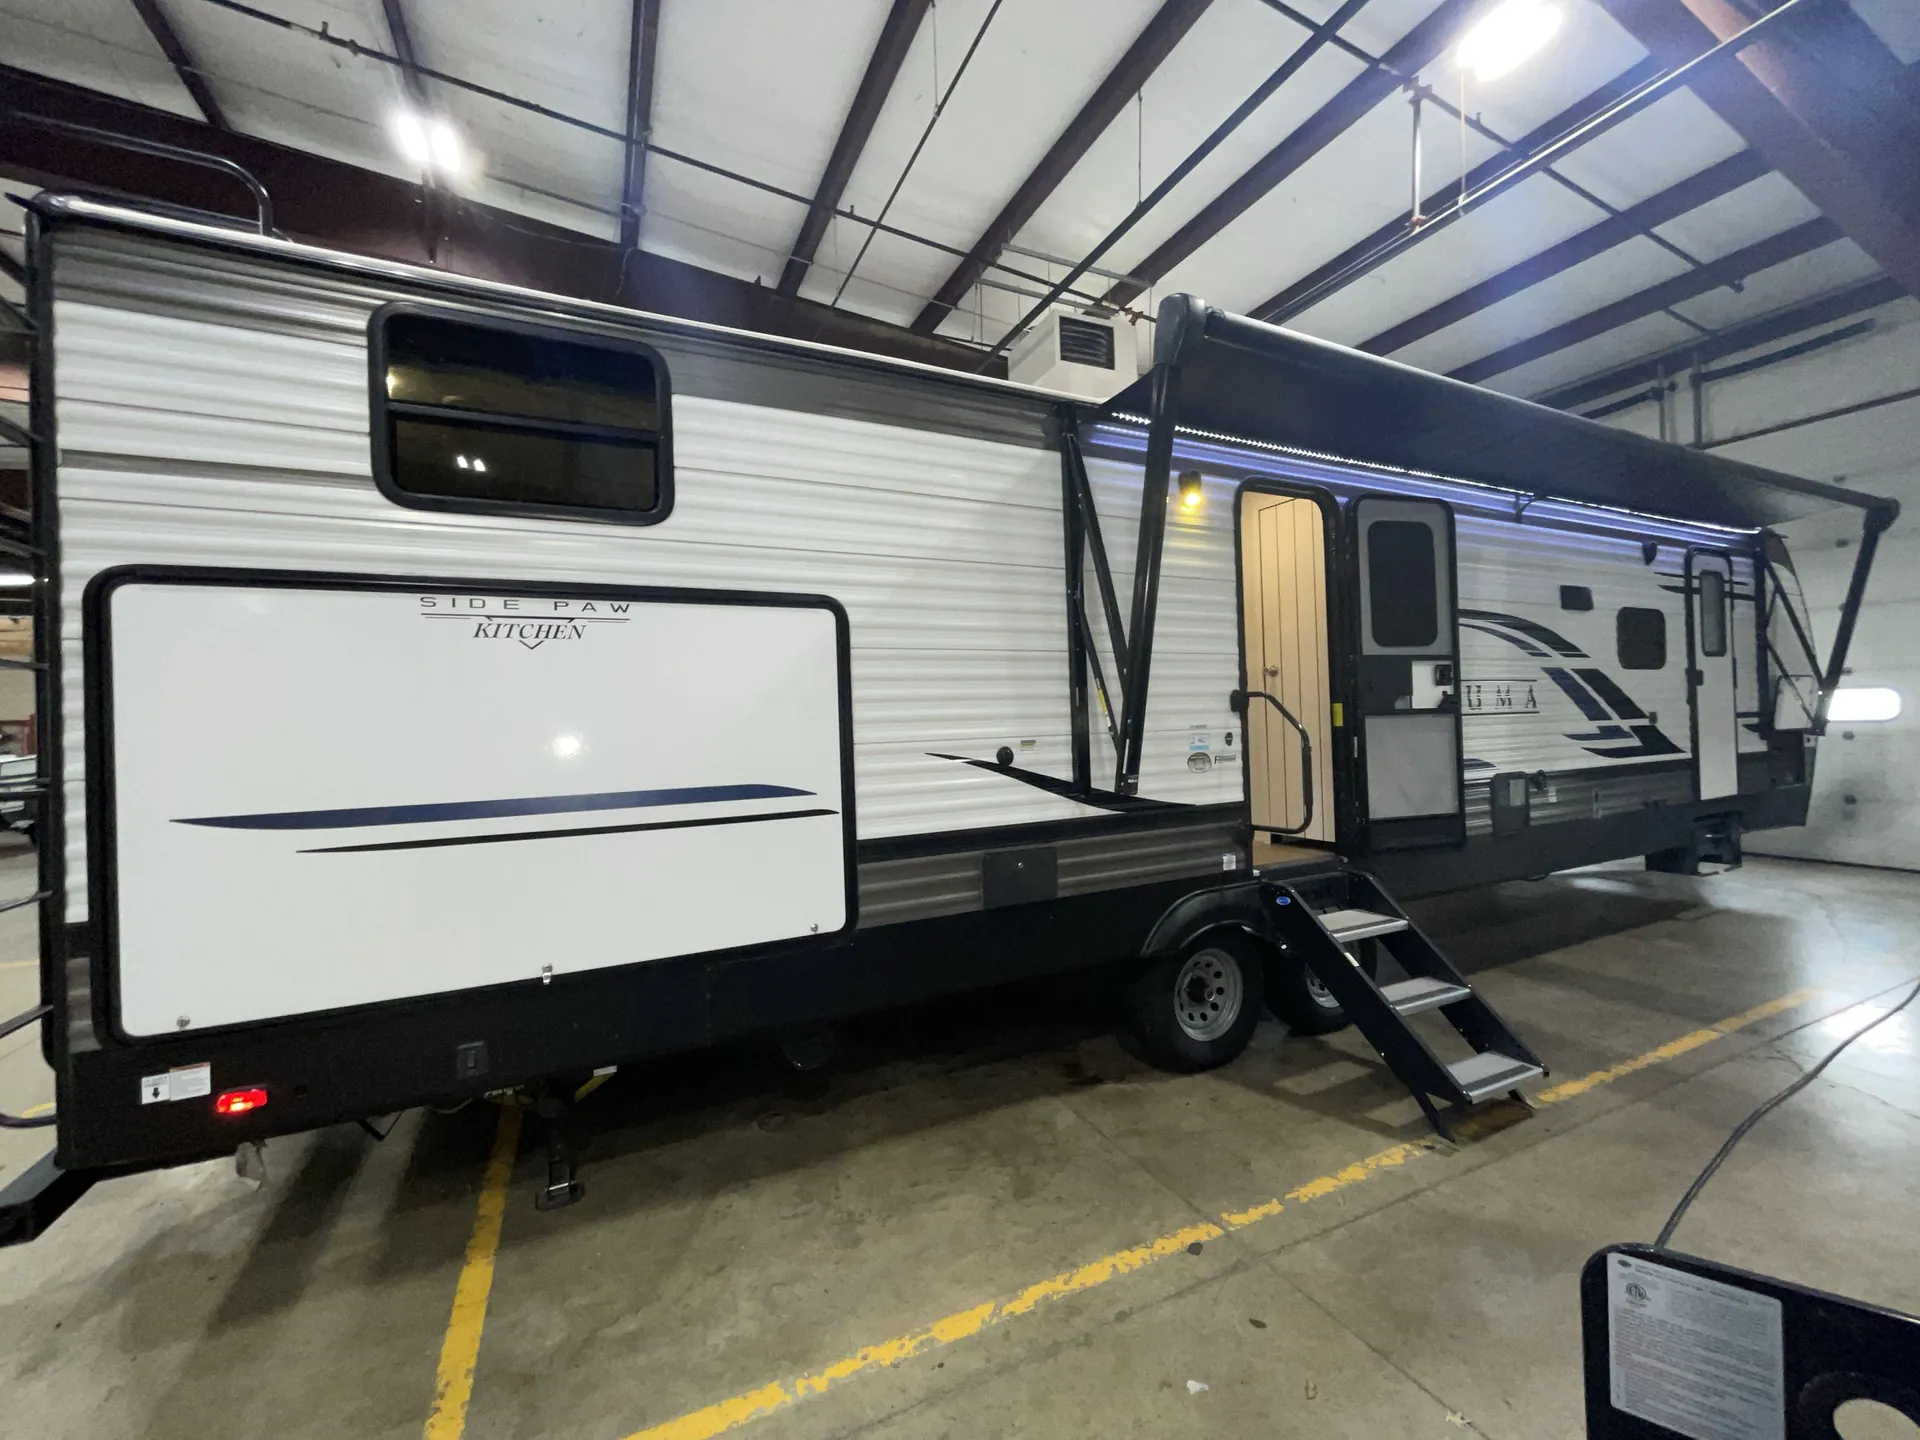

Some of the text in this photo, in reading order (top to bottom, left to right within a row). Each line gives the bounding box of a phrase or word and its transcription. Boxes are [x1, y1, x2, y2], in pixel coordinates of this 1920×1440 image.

[420, 597, 630, 613] SIDE PAW
[473, 622, 587, 640] KITCHEN
[1465, 684, 1538, 710] UMA
